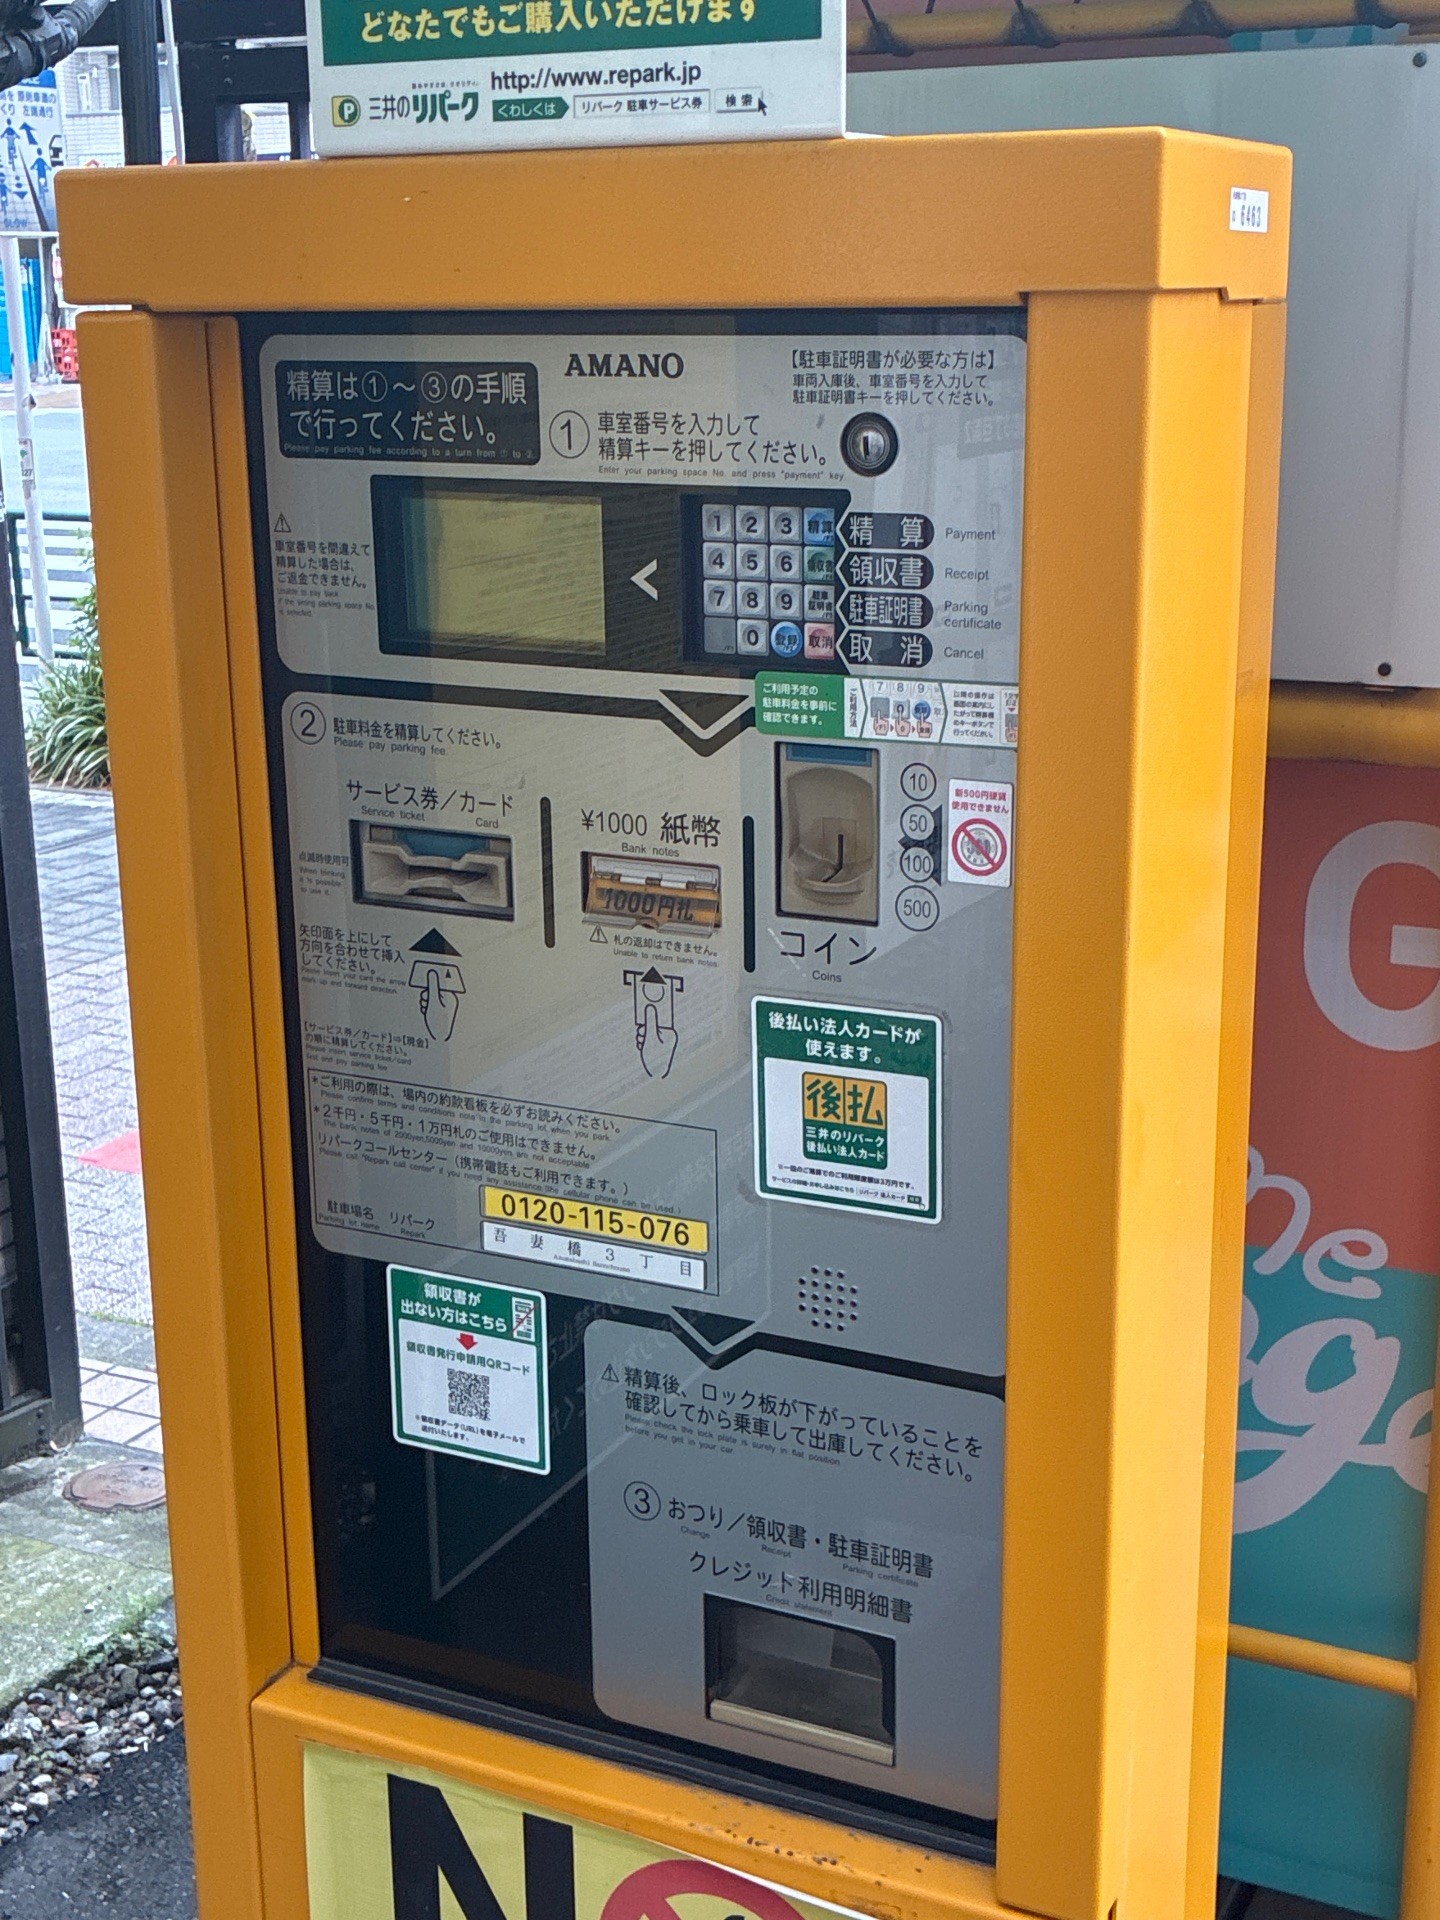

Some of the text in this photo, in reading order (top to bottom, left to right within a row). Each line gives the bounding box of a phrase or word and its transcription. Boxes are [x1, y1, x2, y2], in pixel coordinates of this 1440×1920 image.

[490, 61, 701, 93] http://www.repark.jp
[497, 103, 557, 117] くわしくは
[582, 100, 622, 113] リパーク
[726, 94, 753, 107] 検索
[1241, 204, 1261, 227] 6463
[564, 352, 685, 379] AMANO
[793, 373, 987, 389] 車両入庫後、車室番号を入力して
[793, 389, 994, 406] 駐車証明書キーを押してください。
[290, 408, 496, 444] で行ってください。
[598, 411, 760, 437] 車室番号を入力して
[386, 446, 427, 457] according
[432, 448, 440, 456] to
[455, 448, 472, 457] turn
[477, 448, 496, 457] from
[598, 438, 827, 466] 精算キーを押してください。
[599, 465, 776, 481] Enter your parking space and press
[713, 515, 792, 534] 1 2 3
[945, 527, 996, 542] Payment
[275, 540, 370, 556] 車室番号を間違えて
[712, 553, 792, 572] 4 5 6
[849, 554, 924, 587] 領収書
[278, 571, 367, 588] ご返金できません。
[945, 568, 989, 582] Receipt
[713, 590, 792, 610] 7 8 9
[849, 593, 924, 626] 駐車証明書
[944, 600, 988, 616] Parking
[747, 629, 759, 646] 0
[808, 634, 834, 649] 取消
[944, 646, 985, 659] Cancel
[763, 682, 818, 696] ご利用予定の
[876, 681, 925, 694] 7 8 9
[762, 711, 824, 726] 確認できます。
[333, 717, 501, 749] 駐車料金を精算してください。
[333, 736, 426, 756] Please pay parking
[909, 773, 928, 791] 10
[361, 805, 425, 821] Service ticket
[951, 800, 1010, 814] 使用できません
[476, 817, 499, 829] Card
[581, 808, 721, 847] ¥1000 紙幣
[908, 814, 928, 833] 50
[621, 842, 680, 857] Bank notes
[905, 855, 931, 874] 100
[903, 898, 931, 918] 500
[299, 924, 392, 946] 矢印面を上にして
[300, 940, 406, 964] 方向を合わせて挿入
[613, 948, 673, 962] Unable to return
[780, 930, 878, 965] コイン
[302, 954, 376, 975] してください。
[812, 970, 843, 983] Coins
[769, 1011, 923, 1045] 後払い法人カードが
[805, 1039, 882, 1064] 使えます。
[806, 1079, 884, 1126] 後払
[506, 1119, 534, 1131] parking
[537, 1123, 547, 1131] lot
[575, 1130, 589, 1141] you
[806, 1126, 885, 1148] 三井のリパーク
[361, 1125, 380, 1135] notes
[532, 1153, 545, 1163] not
[806, 1141, 885, 1163] 後払い法人カード
[447, 1168, 460, 1178] you
[594, 1193, 618, 1205] phone
[622, 1198, 637, 1208] can
[327, 1199, 435, 1231] 駐車場名 リパーク
[501, 1193, 690, 1246] 0120-115-076
[424, 1282, 482, 1308] 領収書が
[400, 1298, 508, 1333] 出ない方はこちら
[406, 1340, 530, 1376] 領収書発行申請用QRコード
[624, 1366, 983, 1458] 精算後、ロック板が下がっていることを
[625, 1390, 973, 1482] 確認してから乗車して出庫してください。
[751, 1440, 776, 1454] surely
[842, 1562, 873, 1579] Parking
[689, 1550, 913, 1624] クレジット利用明細書
